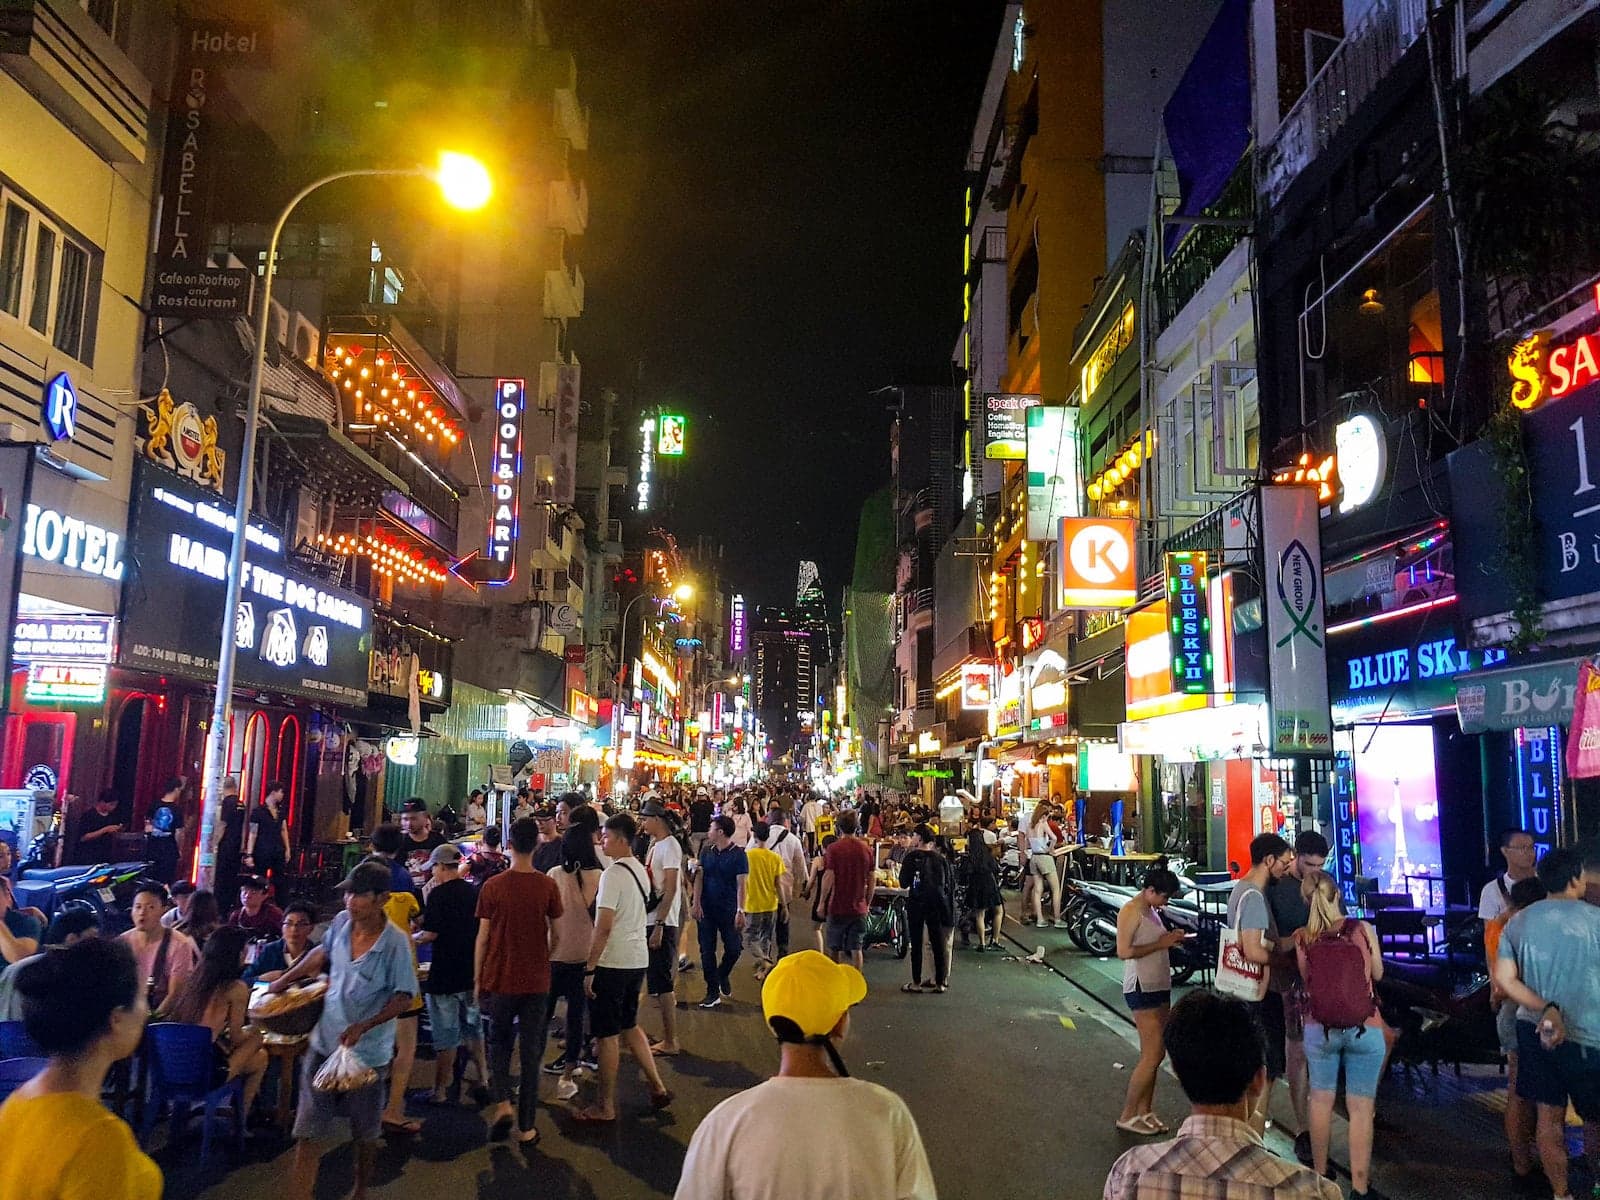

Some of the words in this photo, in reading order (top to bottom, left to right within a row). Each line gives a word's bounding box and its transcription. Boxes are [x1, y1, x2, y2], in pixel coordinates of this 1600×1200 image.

[191, 30, 257, 53] Hotel
[159, 272, 183, 285] Cafe
[184, 275, 197, 285] on
[199, 273, 241, 288] Rooftop
[158, 294, 237, 308] Restaurant
[188, 287, 209, 296] and
[53, 382, 74, 438] R
[987, 397, 1019, 411] Speak
[987, 413, 1013, 422] Coffee
[987, 430, 1014, 440] English
[169, 533, 226, 580] HAIR
[227, 560, 251, 588] F
[285, 579, 317, 612] DOG
[1292, 554, 1302, 577] NEW
[1294, 577, 1304, 612] GROUP
[1348, 648, 1411, 690] BLUE
